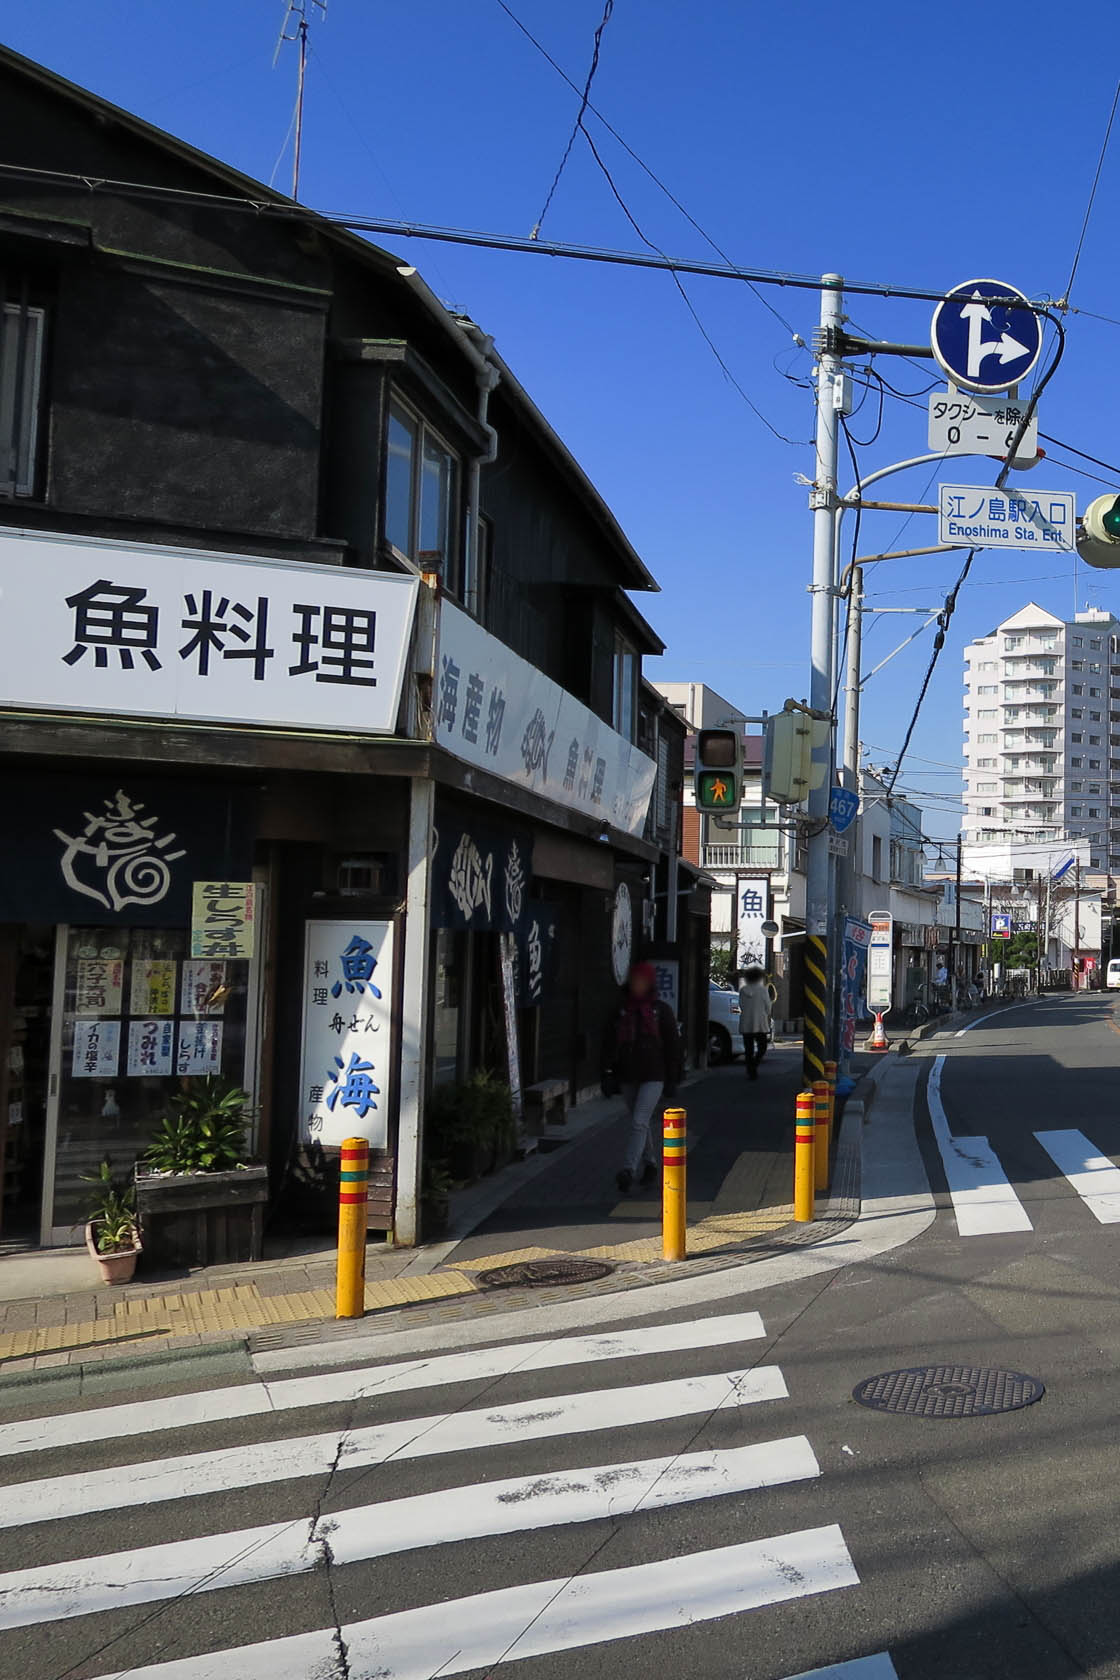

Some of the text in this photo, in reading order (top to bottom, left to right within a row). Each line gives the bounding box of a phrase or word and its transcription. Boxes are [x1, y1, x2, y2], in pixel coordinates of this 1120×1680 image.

[947, 495, 1066, 525] 江ノ島駅入口
[949, 523, 1065, 543] Enoshima Sta. Ent.
[61, 579, 377, 687] 魚料理
[437, 654, 506, 757] 海産物
[830, 797, 854, 818] 467
[202, 883, 247, 957] 生しらす丼
[741, 888, 764, 919] 魚
[312, 959, 329, 1006] 料理
[331, 935, 382, 1000] 魚
[84, 1022, 101, 1073] イカの塩辛
[140, 1021, 159, 1066] つみれ
[177, 1039, 192, 1073] しらす
[308, 1084, 324, 1132] 産物
[325, 1051, 380, 1119] 海
